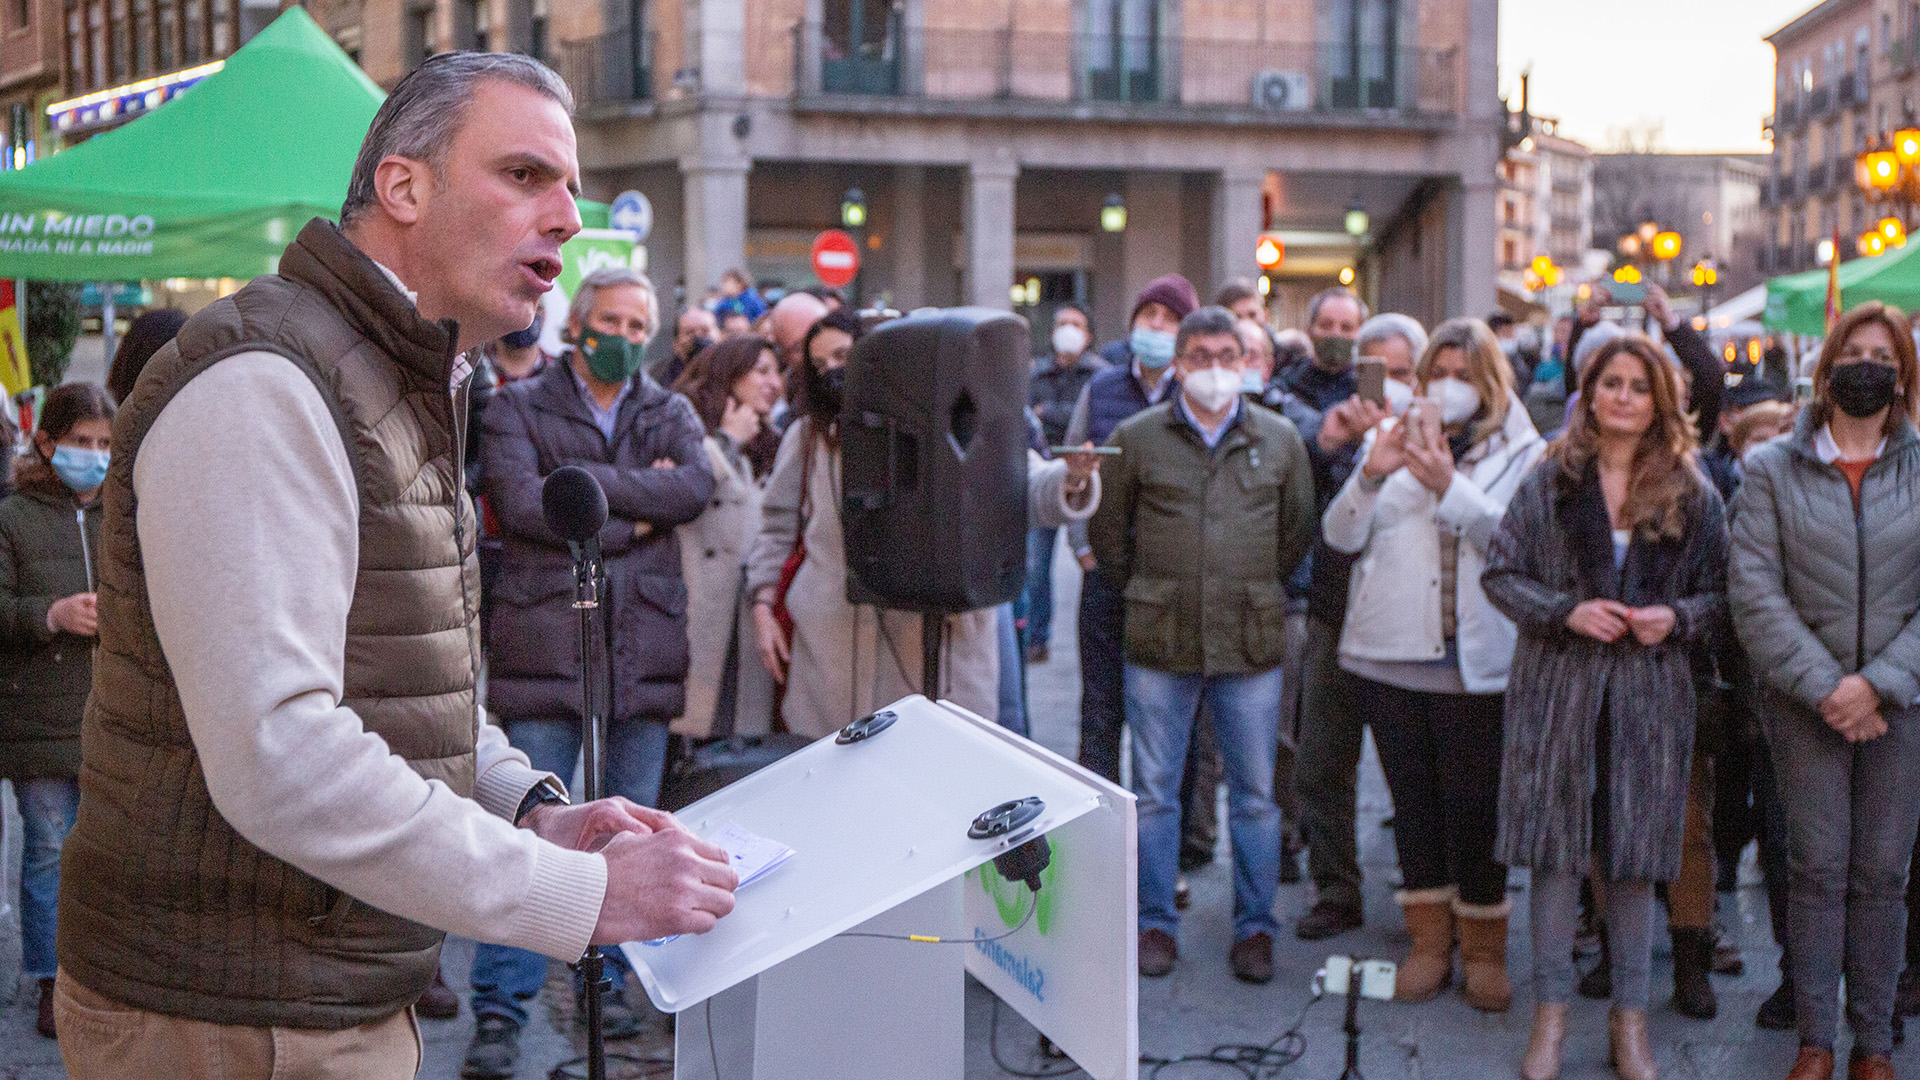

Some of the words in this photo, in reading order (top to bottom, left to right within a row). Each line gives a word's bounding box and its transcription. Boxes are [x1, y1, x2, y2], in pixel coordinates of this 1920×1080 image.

[43, 213, 155, 237] MIEDO
[55, 240, 75, 254] NI
[78, 240, 92, 254] A
[97, 240, 154, 255] NADIE
